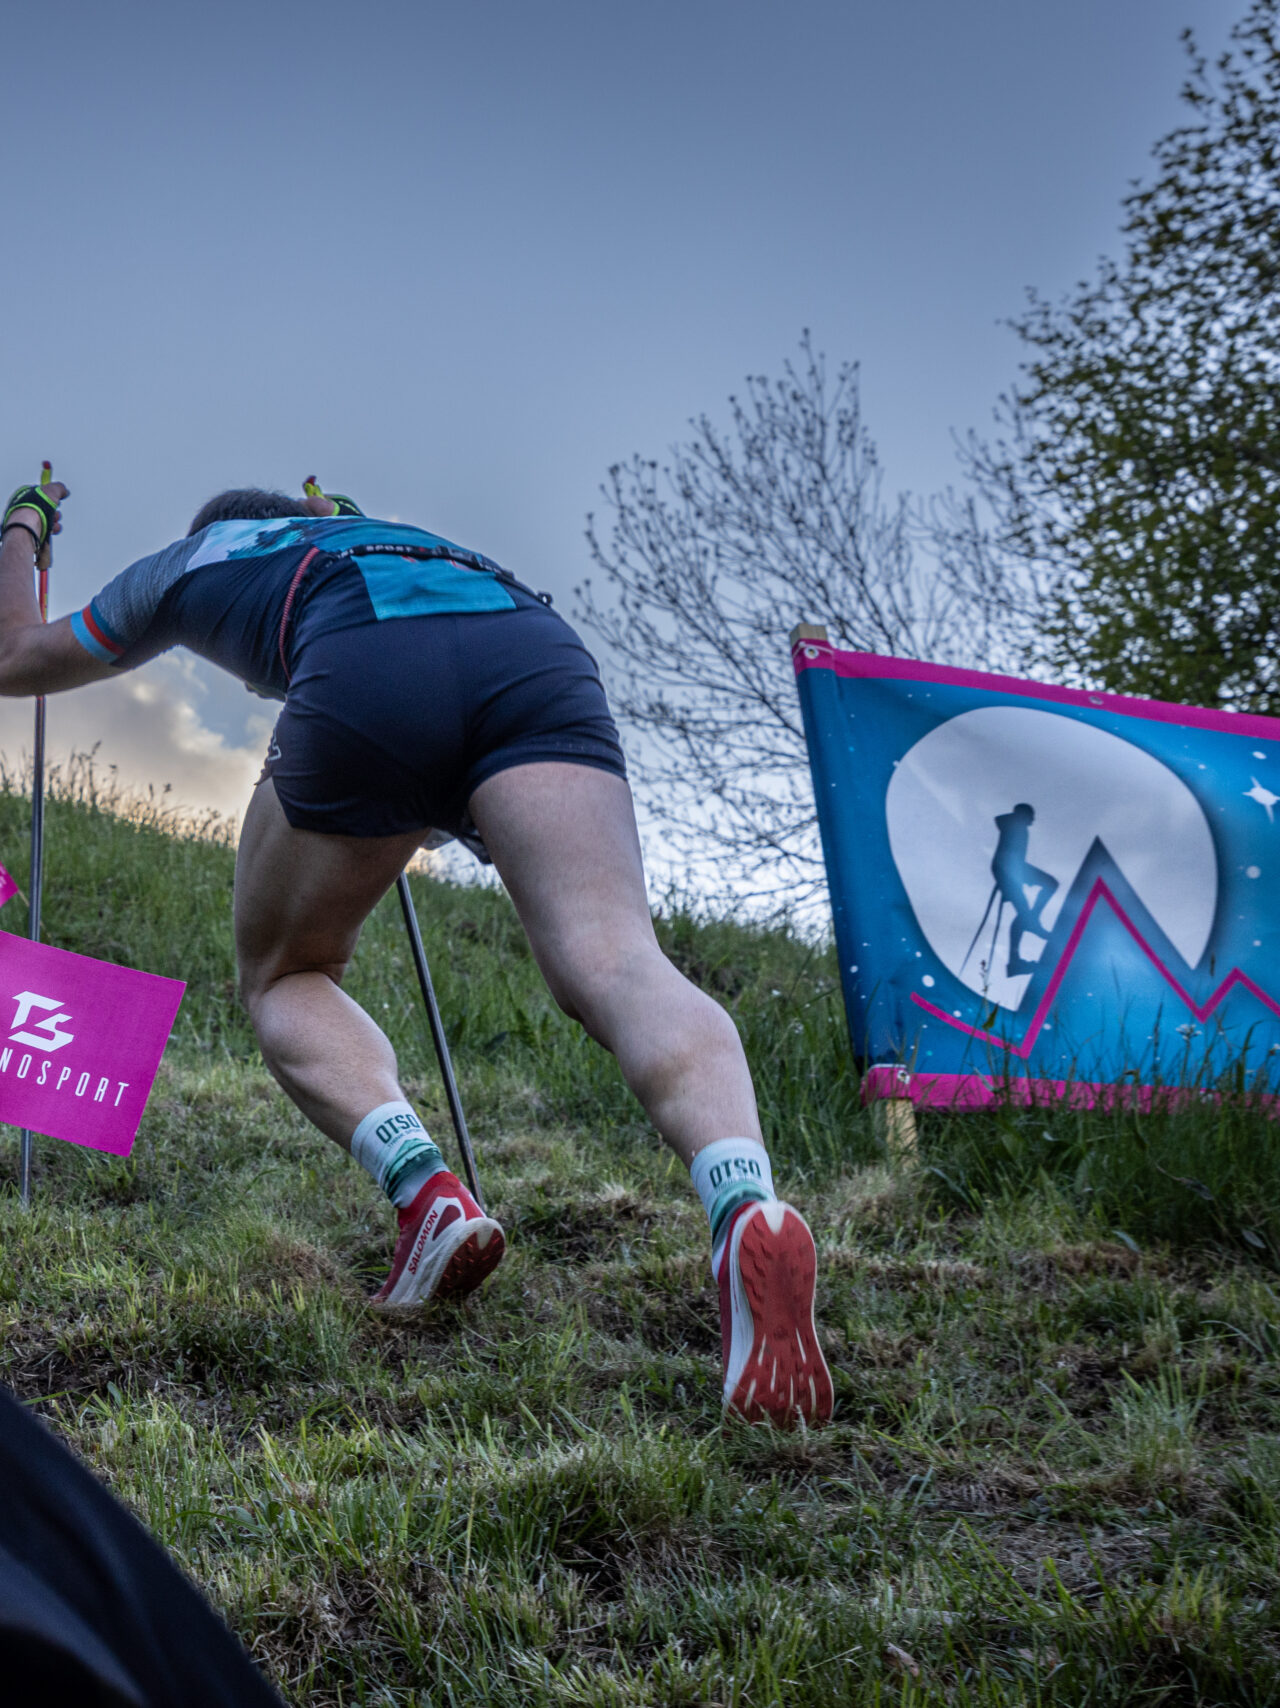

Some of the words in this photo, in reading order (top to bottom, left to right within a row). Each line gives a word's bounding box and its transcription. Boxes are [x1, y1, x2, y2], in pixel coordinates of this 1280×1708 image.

[375, 1113, 422, 1145] OTSO
[709, 1157, 762, 1189] OTSO
[407, 1209, 439, 1276] SALOMON
